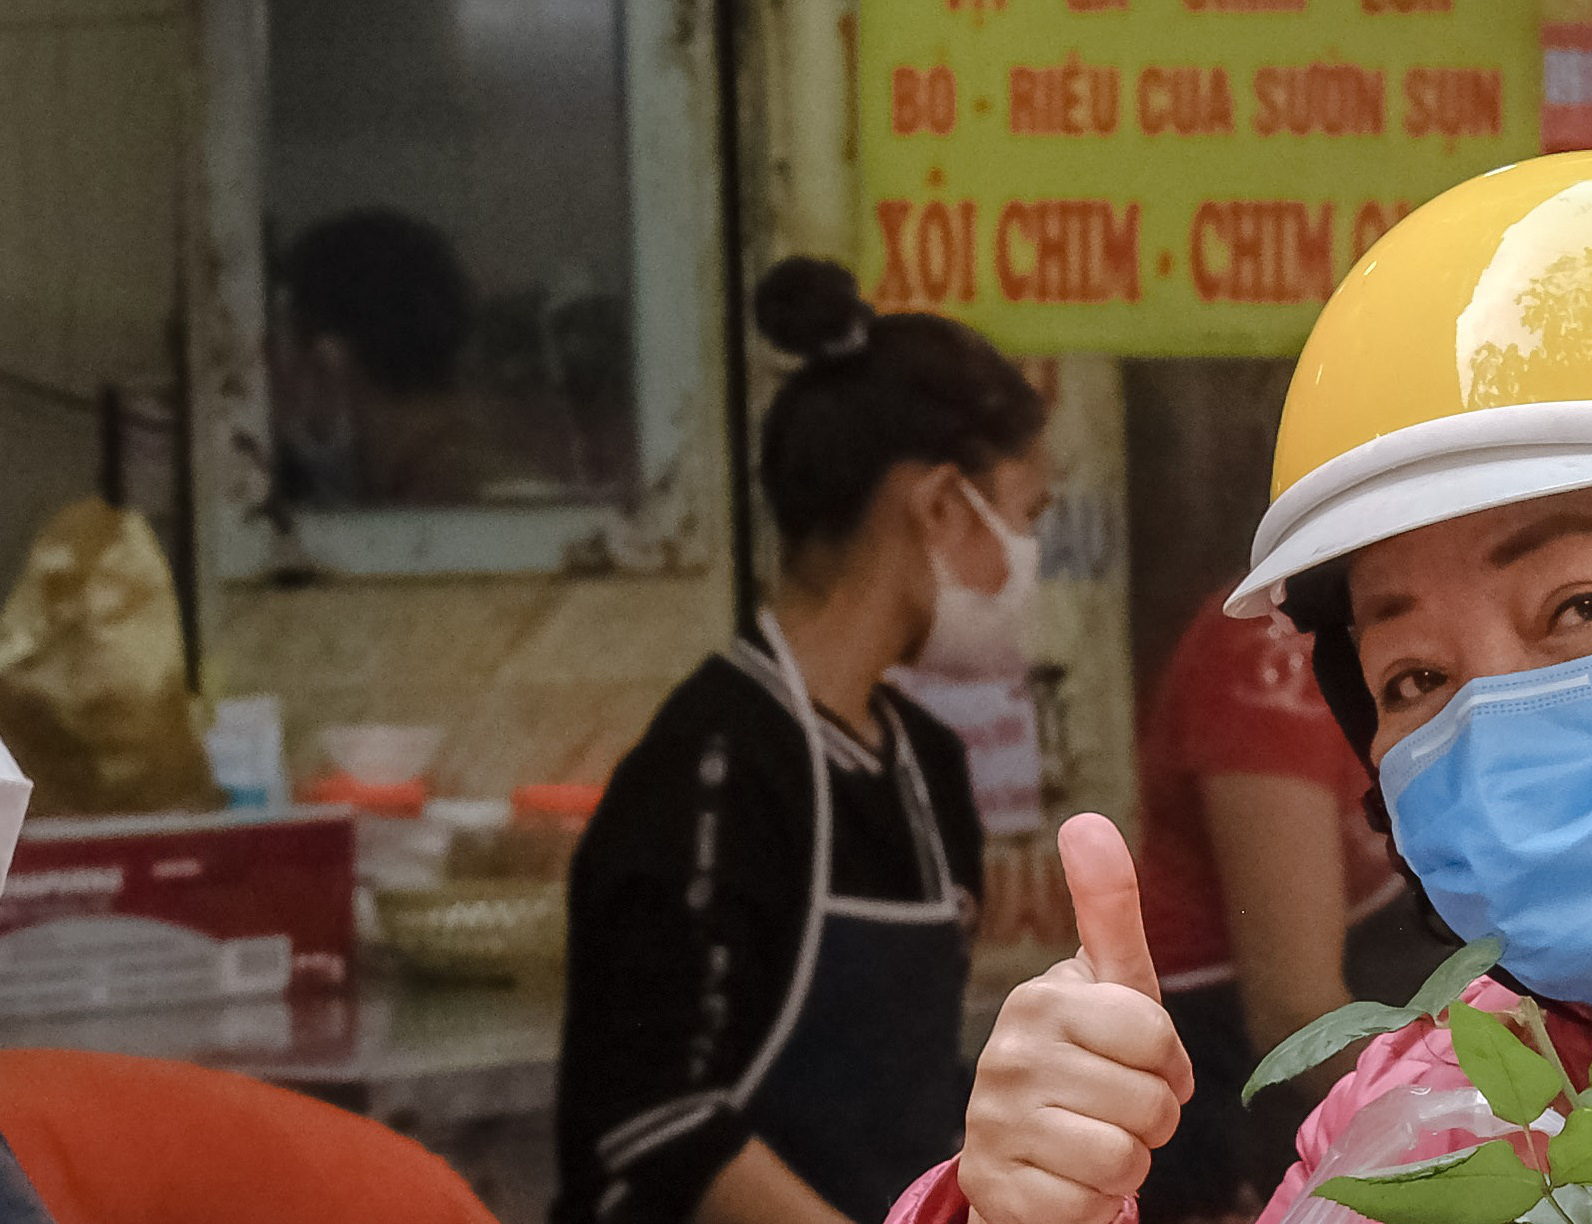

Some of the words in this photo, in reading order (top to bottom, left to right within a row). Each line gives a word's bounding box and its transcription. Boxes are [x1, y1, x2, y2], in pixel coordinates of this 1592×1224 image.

[1137, 64, 1235, 136] CUA
[995, 198, 1140, 303] CHIM
[1189, 198, 1333, 303] CHIM
